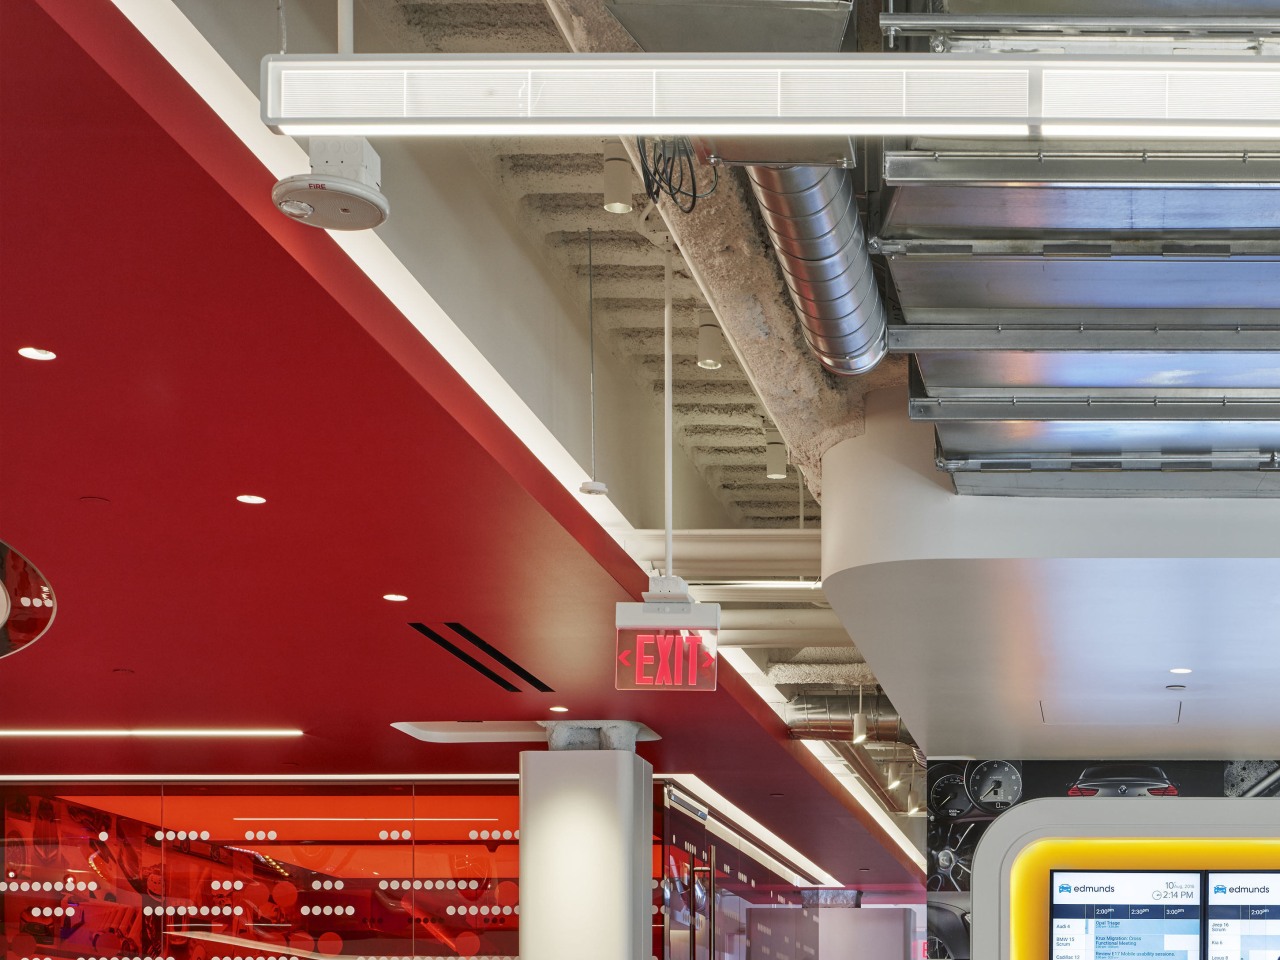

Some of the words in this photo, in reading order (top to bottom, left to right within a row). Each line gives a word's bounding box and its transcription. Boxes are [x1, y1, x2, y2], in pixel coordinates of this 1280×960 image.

[635, 635, 702, 685] EXIT
[1074, 885, 1115, 893] edmunds
[1165, 881, 1174, 889] 10
[1229, 885, 1270, 894] edmunds
[1162, 891, 1178, 899] 2:14
